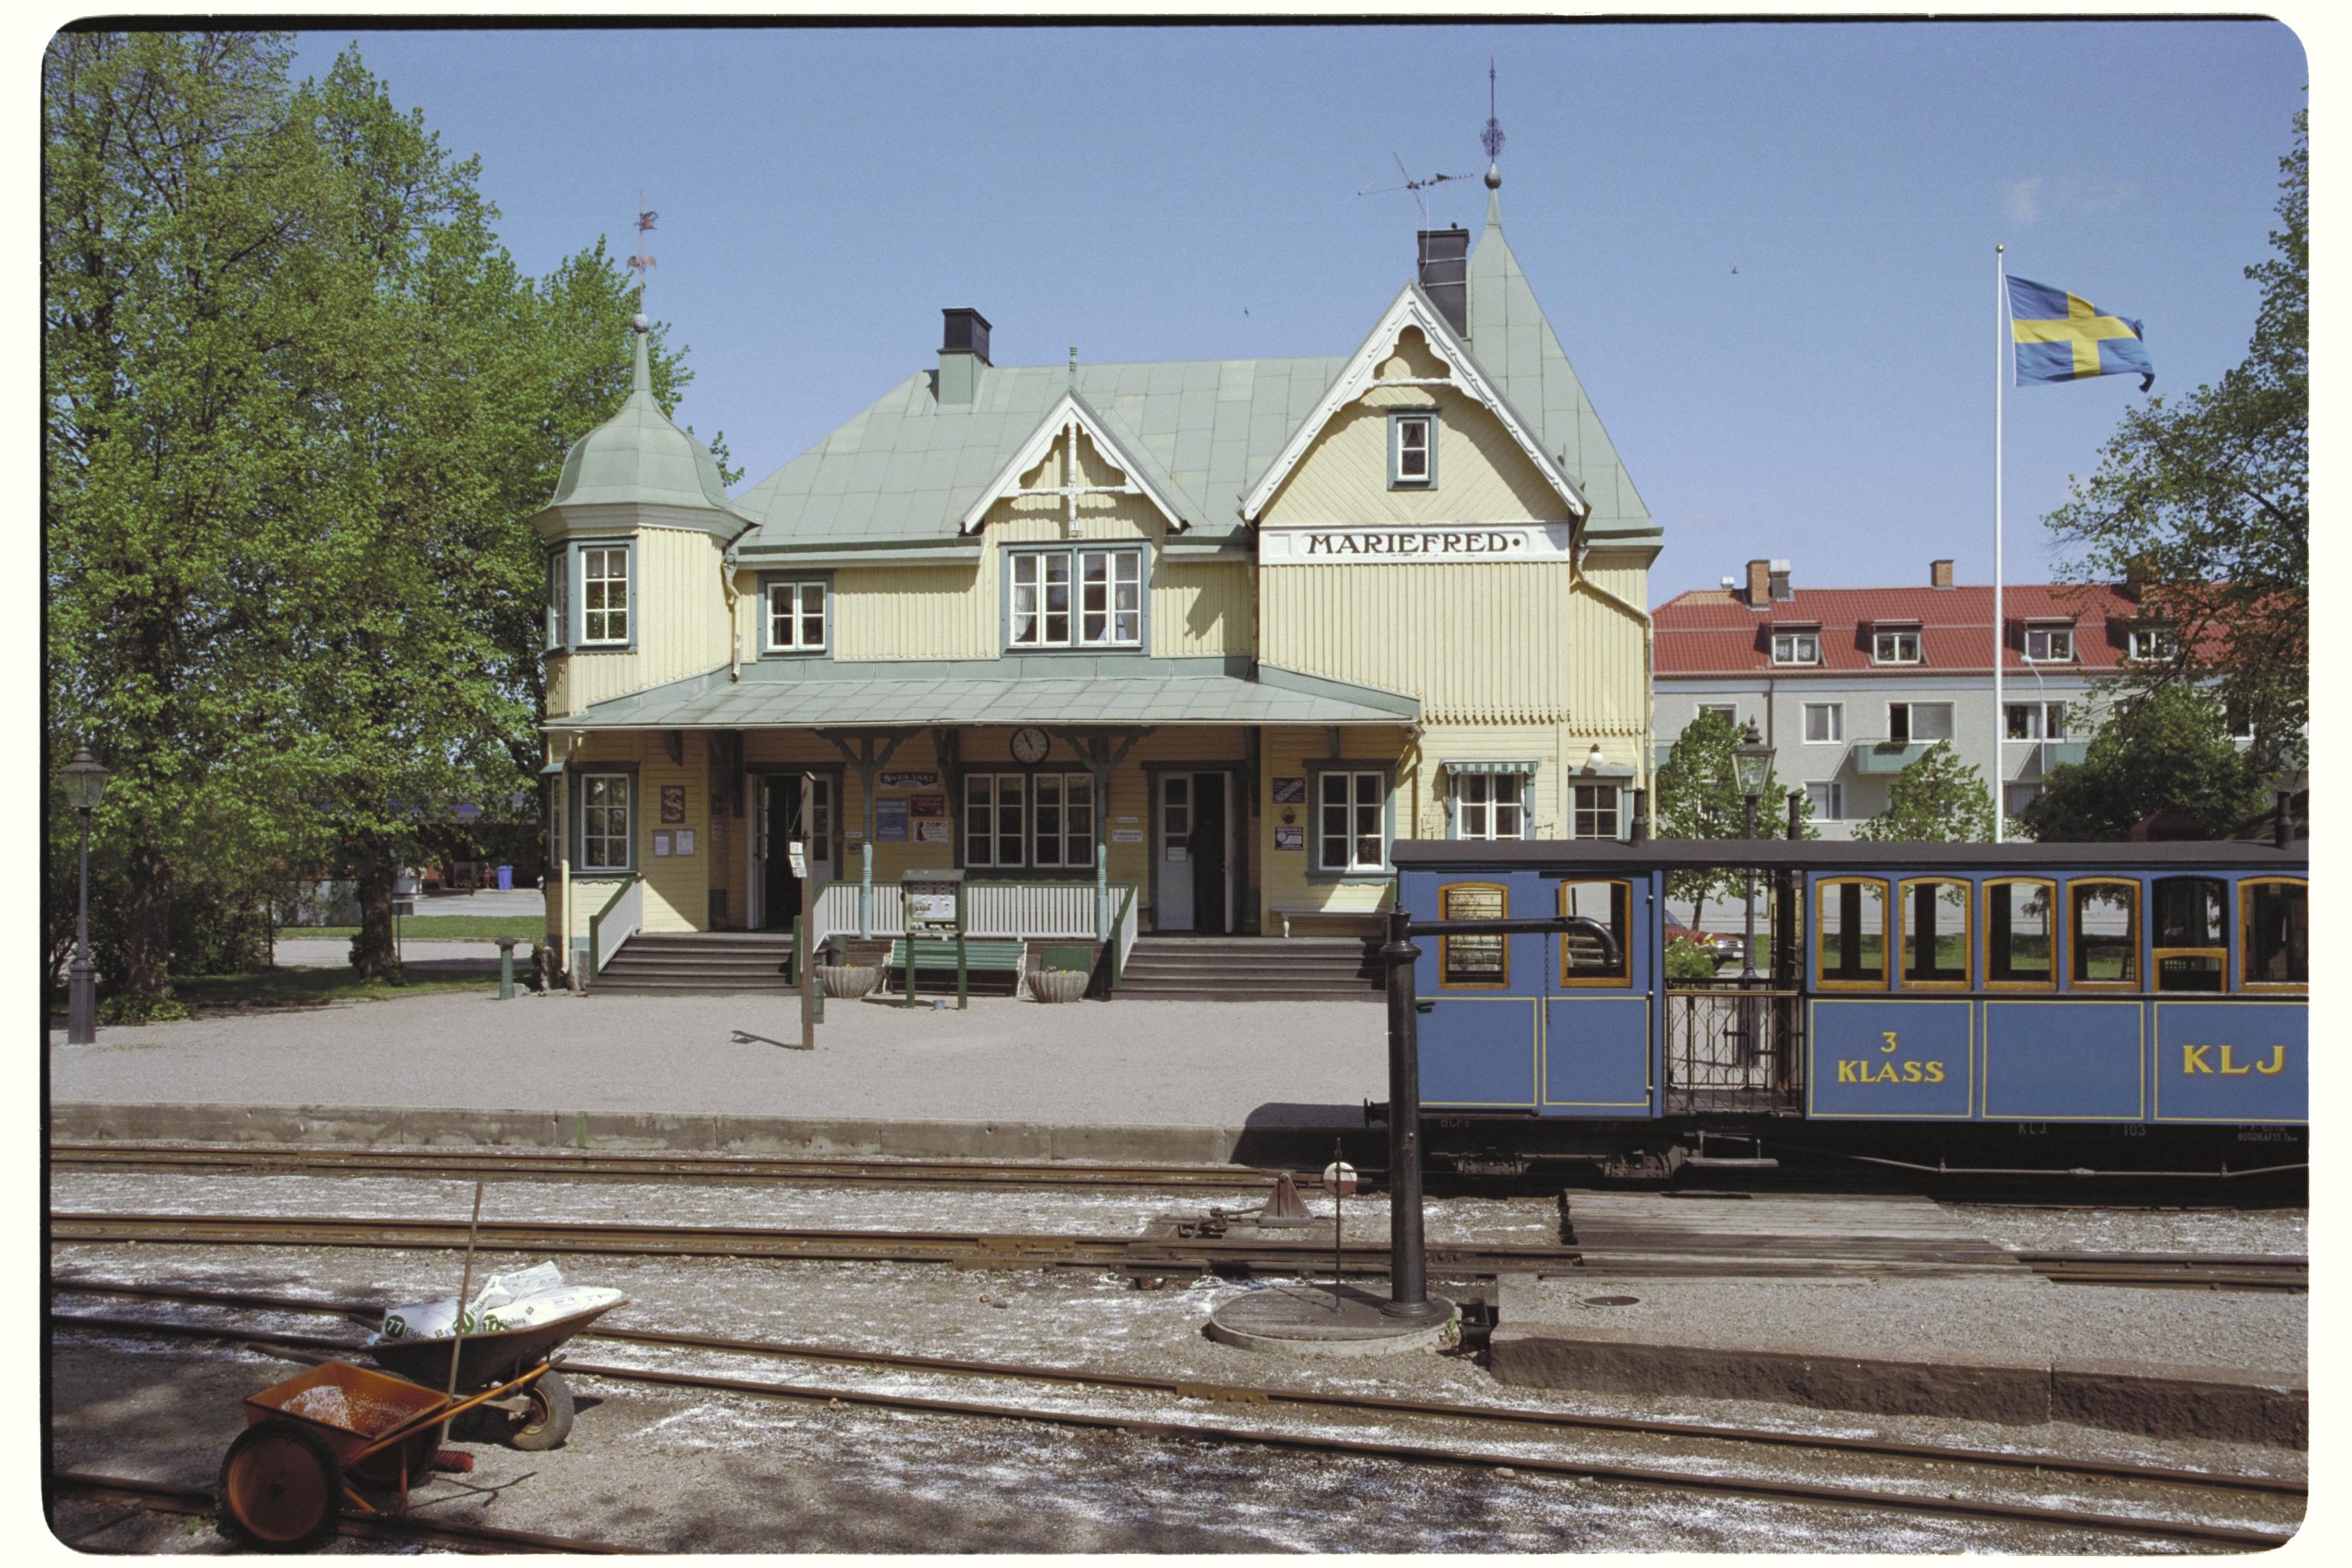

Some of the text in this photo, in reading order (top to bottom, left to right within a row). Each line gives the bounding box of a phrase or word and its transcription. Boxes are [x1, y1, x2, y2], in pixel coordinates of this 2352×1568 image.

[1880, 1031, 1897, 1054] 3
[1838, 1060, 1945, 1083] KLASS
[387, 1319, 403, 1334] 77
